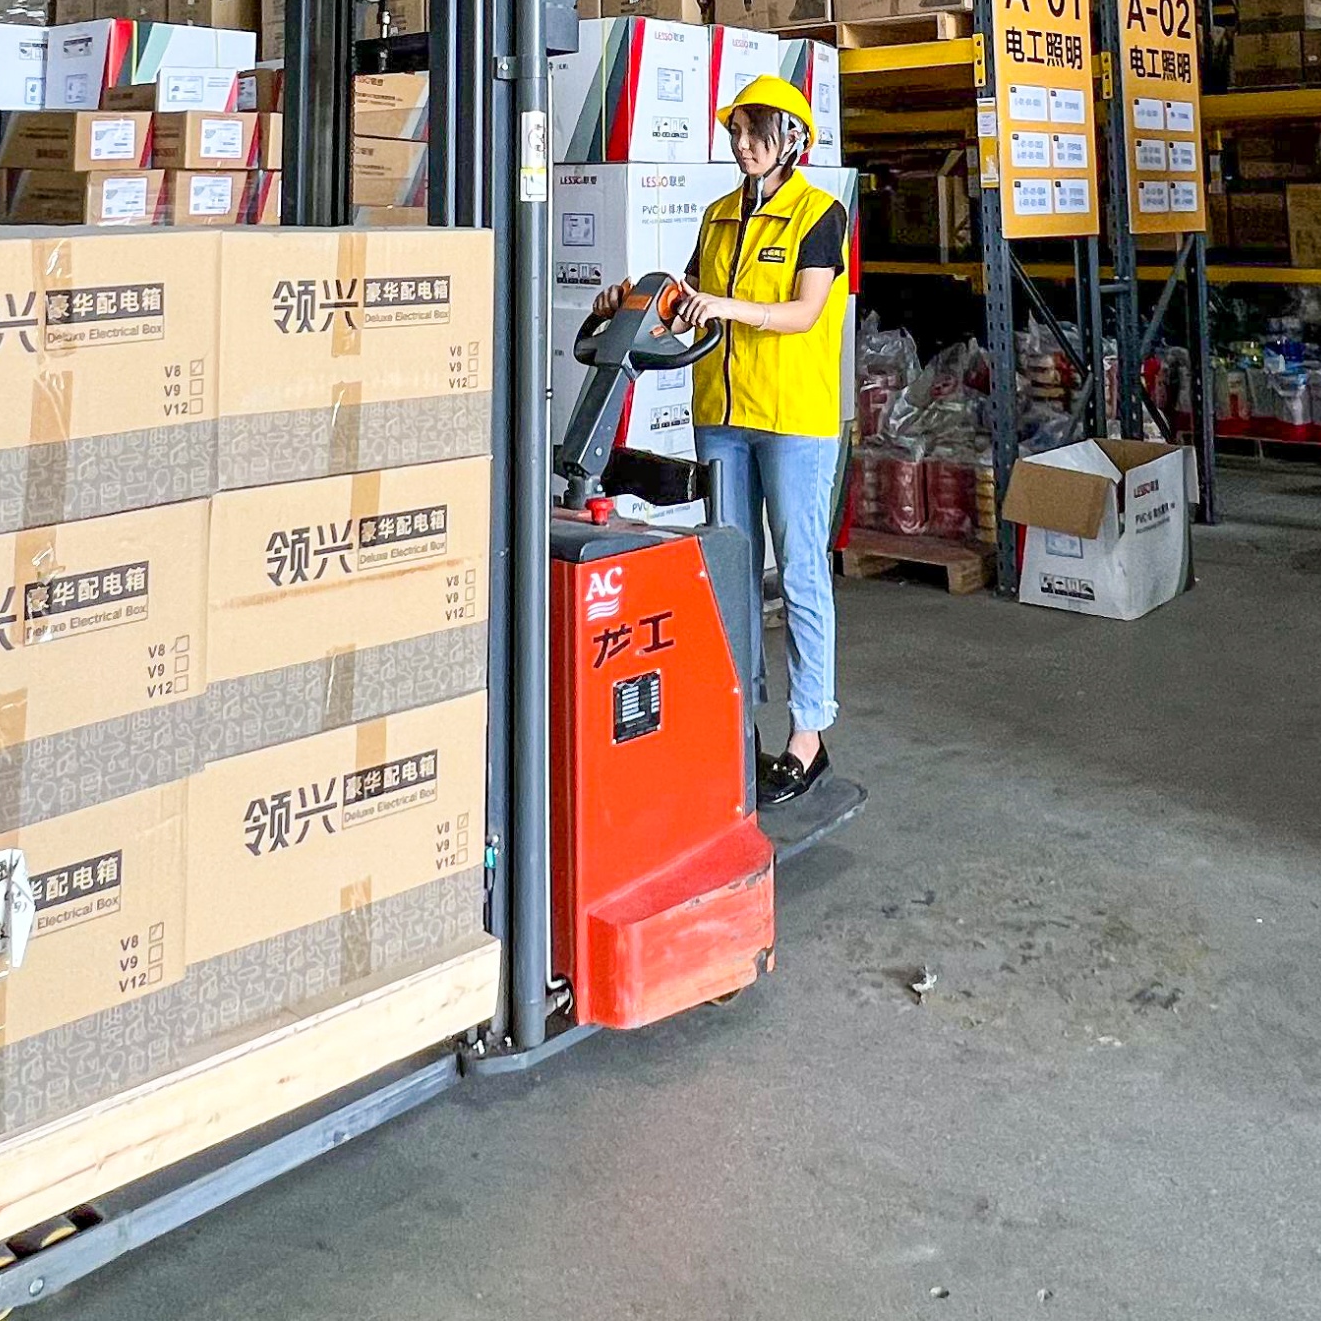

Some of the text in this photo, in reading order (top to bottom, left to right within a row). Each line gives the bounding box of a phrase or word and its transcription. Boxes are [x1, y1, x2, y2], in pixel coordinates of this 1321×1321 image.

[1005, 26, 1083, 70] 电工照明
[1130, 45, 1192, 84] 电工照明
[642, 205, 666, 215] PVCU
[366, 279, 449, 303] 豪华配电箱
[47, 288, 162, 321] 豪华配电箱
[272, 278, 359, 334] 领兴
[395, 311, 432, 322] Electrical
[434, 309, 449, 319] Box
[89, 324, 140, 341] Electrical
[142, 322, 163, 334] Box
[450, 345, 462, 357] V8
[164, 365, 181, 378] V8
[449, 362, 462, 373] V9
[164, 384, 181, 397] V9
[449, 377, 467, 389] V12
[163, 402, 189, 417] V12
[360, 509, 445, 543] 豪华配电箱
[265, 519, 354, 586] 领兴
[390, 544, 428, 559] Electrical
[430, 540, 446, 551] Box
[446, 575, 460, 587] V8
[585, 566, 623, 602] AC
[446, 592, 459, 604] V9
[70, 608, 122, 629] Electrical
[125, 604, 147, 617] Box
[445, 607, 464, 621] V12
[148, 645, 166, 658] V8
[147, 664, 165, 679] V9
[147, 682, 173, 698] V12
[345, 755, 436, 800] 豪华配电箱
[377, 793, 418, 815] Electrical
[419, 786, 436, 801] Box
[244, 777, 337, 856] 领兴
[436, 821, 450, 834] V8
[436, 838, 450, 852] V9
[435, 854, 456, 871] V12
[28, 854, 119, 902] 华配电箱
[37, 895, 119, 930] Electrical Box
[120, 936, 139, 951] V8
[119, 955, 138, 972] V9
[118, 973, 147, 993] V12
